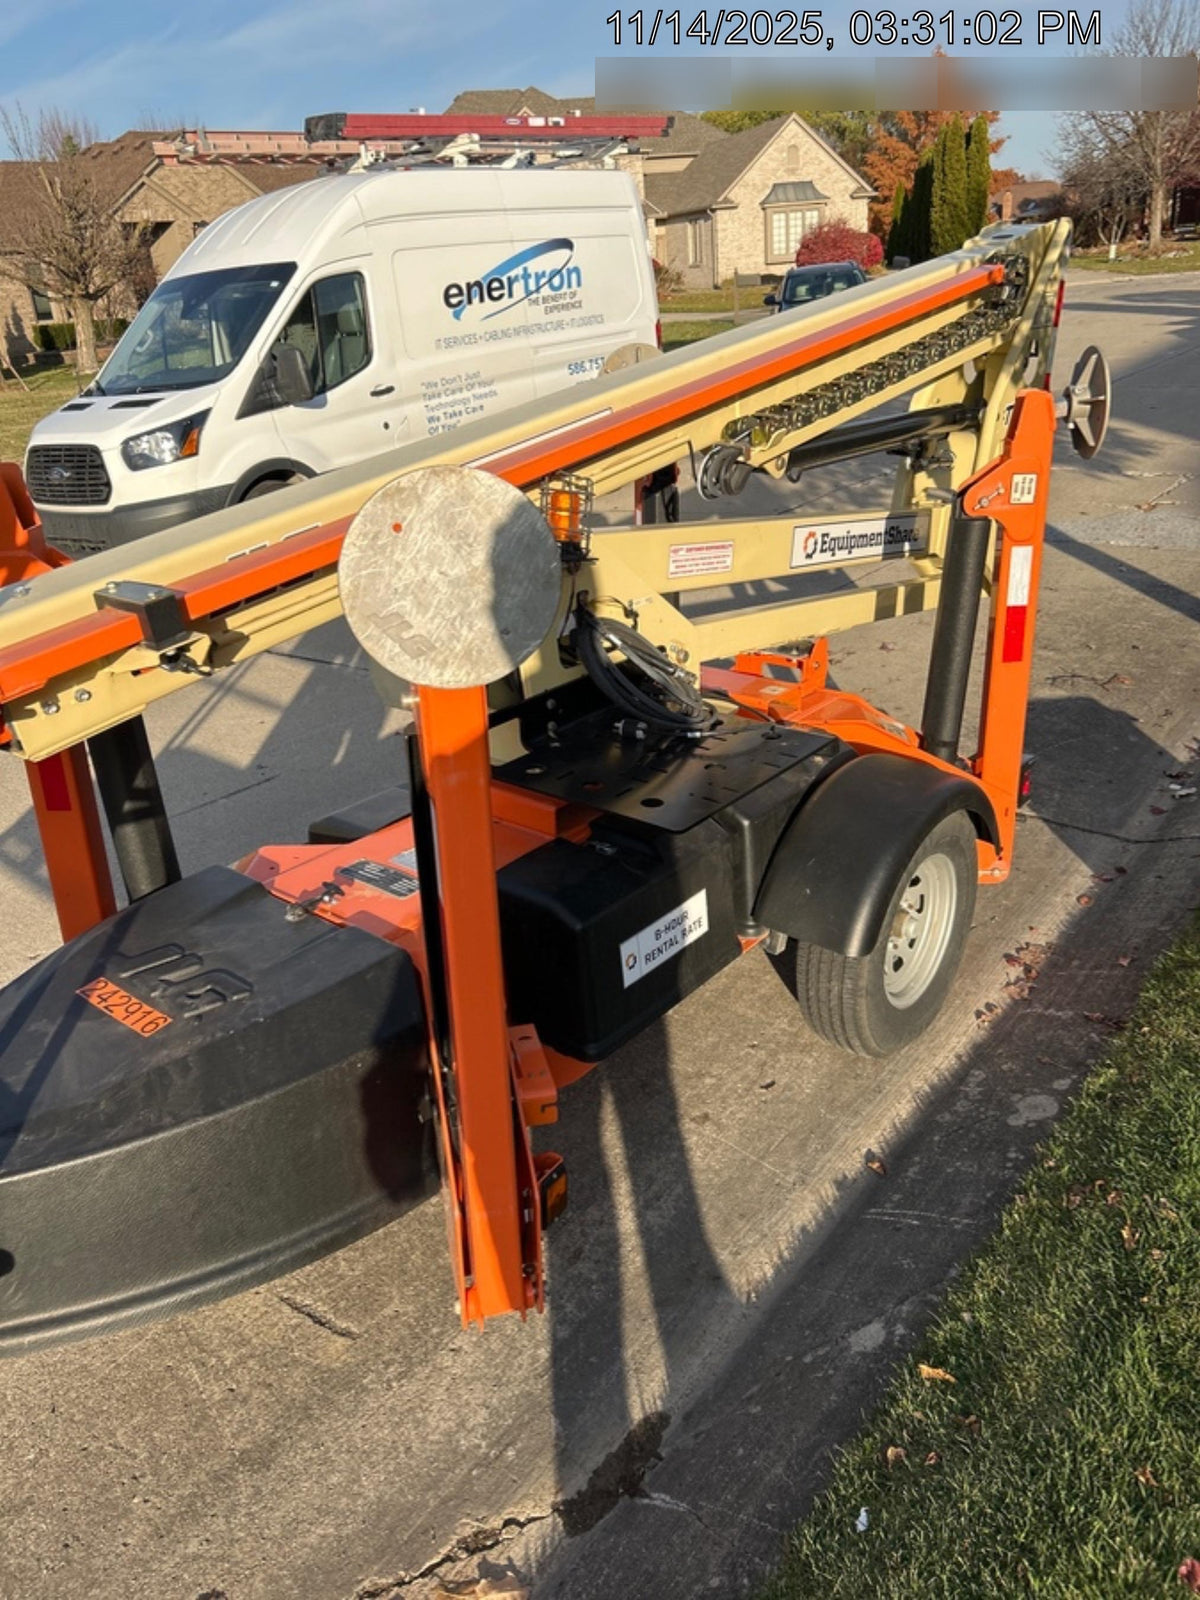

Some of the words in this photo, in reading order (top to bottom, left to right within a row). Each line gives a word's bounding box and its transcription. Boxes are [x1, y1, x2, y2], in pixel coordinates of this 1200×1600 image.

[443, 265, 582, 309] enertron
[527, 297, 540, 306] THE
[541, 291, 567, 304] BENEFIT
[568, 290, 577, 299] OF
[544, 300, 583, 315] EXPERIENCE
[443, 333, 478, 349] SERVICES
[484, 328, 513, 342] CABLING
[513, 319, 565, 337] INFRASTRUCTURE
[423, 391, 442, 401] Take
[443, 386, 463, 397] Care
[424, 396, 471, 413] Technology
[472, 389, 498, 400] Needs
[427, 414, 440, 425] We
[443, 408, 463, 420] Take
[464, 404, 484, 415] Care
[427, 425, 440, 436] Of
[819, 525, 920, 557] EquipmentShare
[644, 935, 679, 965] RENTAL
[680, 917, 703, 940] RATE
[79, 980, 169, 1034] 242916
